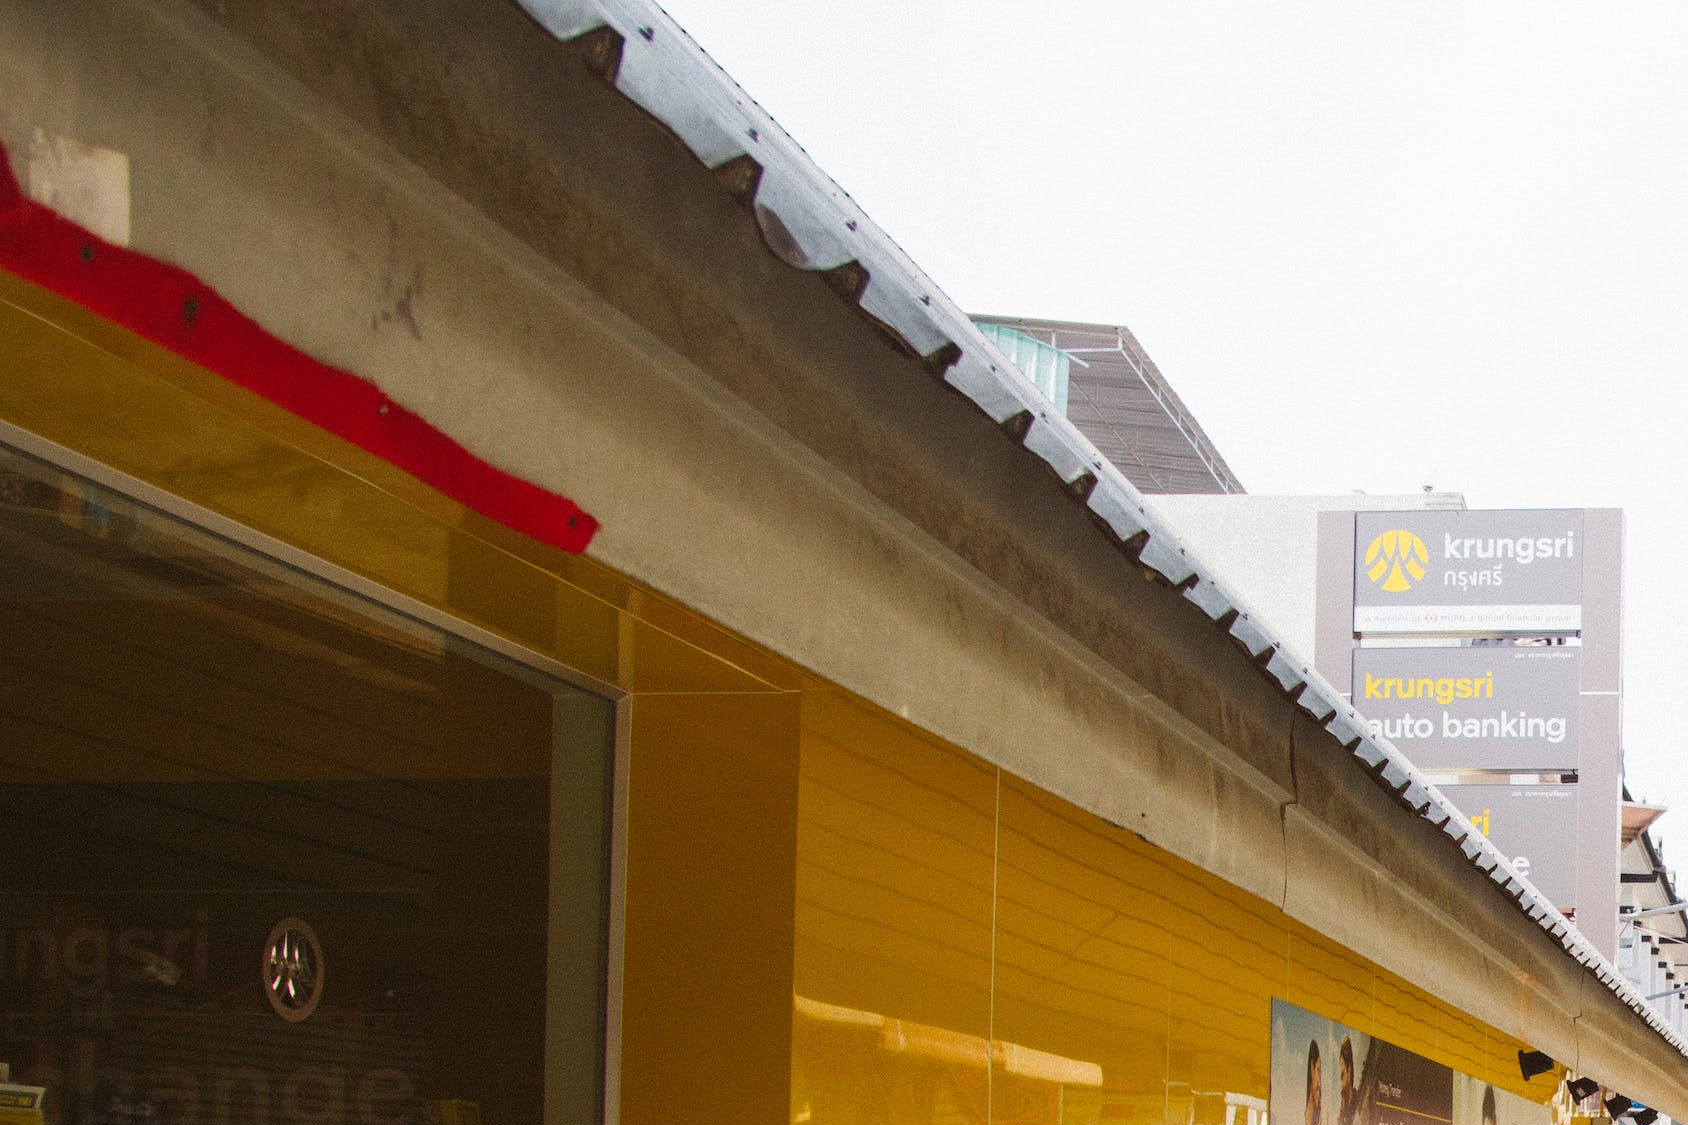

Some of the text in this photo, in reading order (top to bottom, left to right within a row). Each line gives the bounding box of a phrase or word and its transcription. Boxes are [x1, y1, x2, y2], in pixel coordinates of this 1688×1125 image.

[1444, 531, 1574, 564] krungsri
[1444, 564, 1503, 591] กรุงศรี
[1365, 671, 1493, 705] krungsri
[1368, 711, 1566, 743] auto banking
